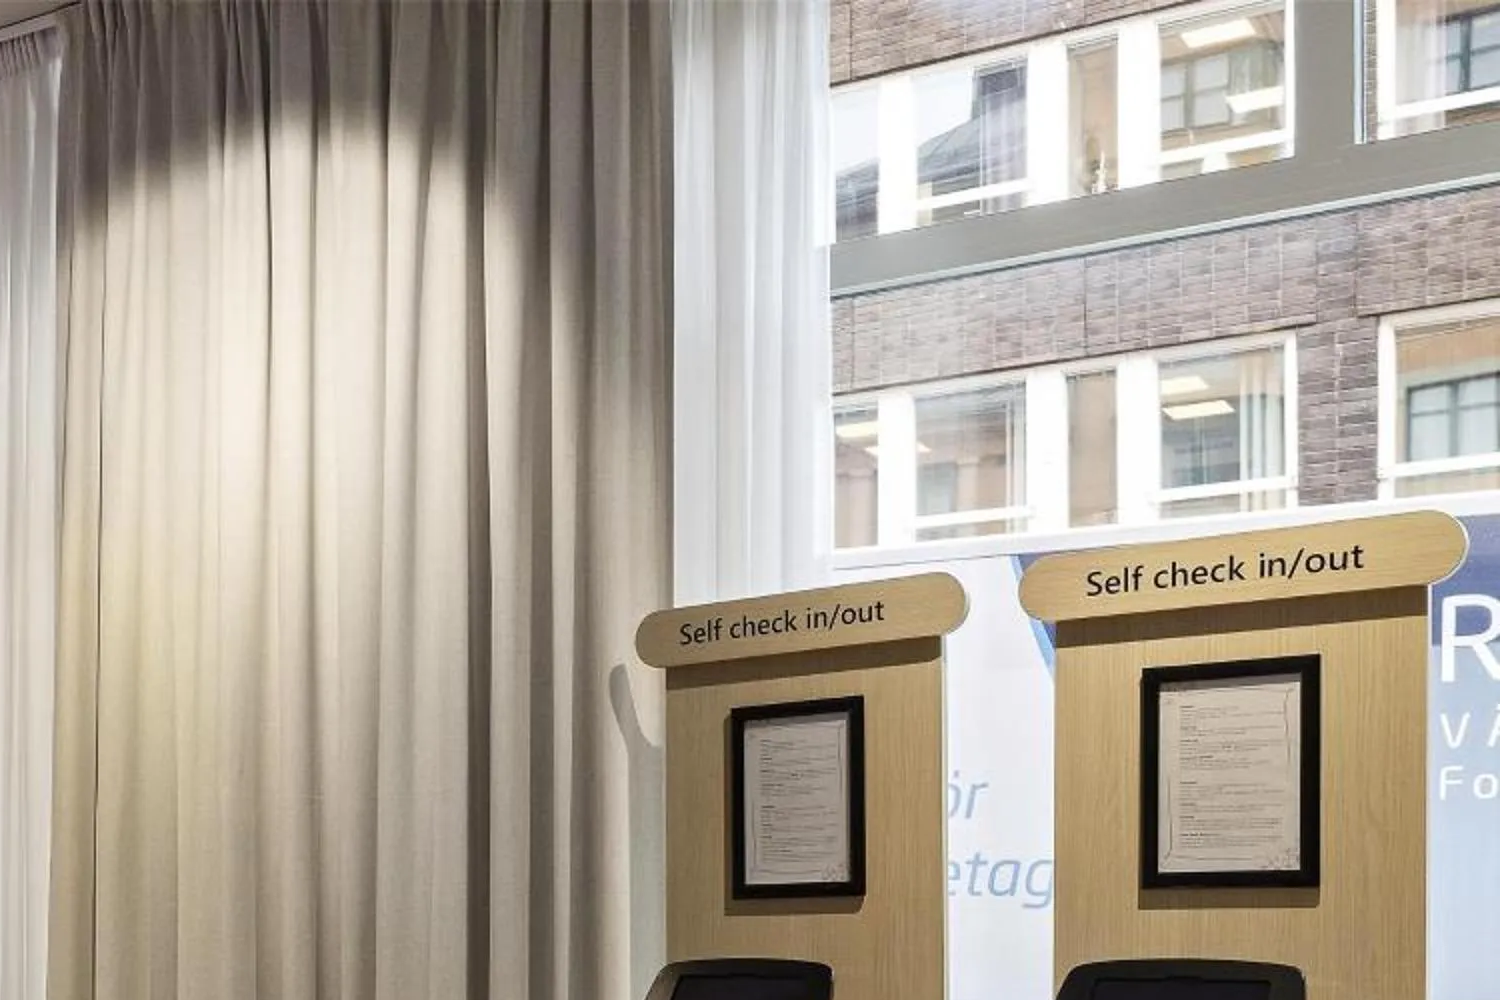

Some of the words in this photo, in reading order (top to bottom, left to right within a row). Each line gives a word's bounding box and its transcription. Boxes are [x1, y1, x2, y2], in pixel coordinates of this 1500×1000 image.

[1087, 566, 1144, 597] Self
[1153, 555, 1246, 589] check
[1258, 544, 1365, 580] in/out
[679, 617, 722, 646] Self
[728, 610, 798, 640] check
[805, 600, 885, 631] in/out
